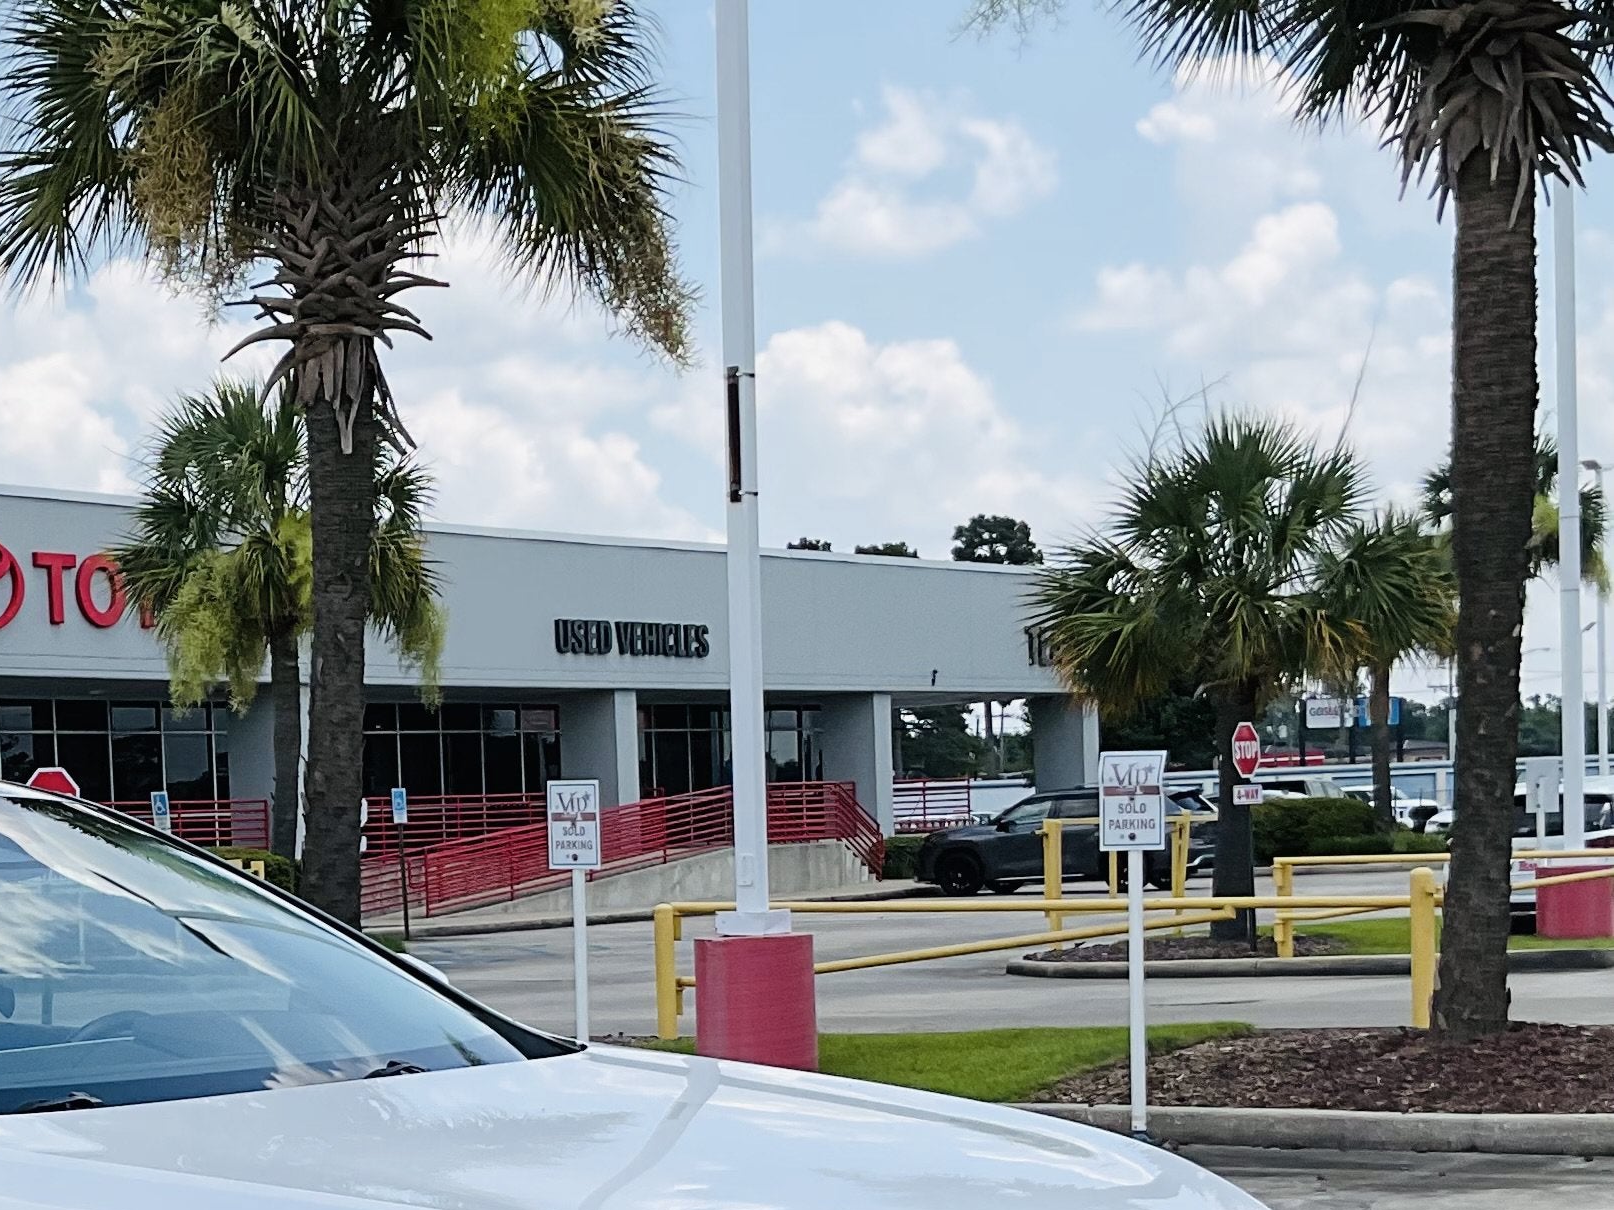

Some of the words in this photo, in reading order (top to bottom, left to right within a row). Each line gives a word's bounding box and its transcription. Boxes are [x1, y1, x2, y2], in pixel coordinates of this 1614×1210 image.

[554, 619, 613, 655] USED
[614, 621, 710, 658] VEHICLES
[1234, 740, 1258, 760] STOP
[1236, 788, 1259, 800] 4-WAY
[1117, 802, 1147, 814] SOLD
[1108, 818, 1156, 830] PARKING
[562, 826, 586, 837] SOLD
[555, 840, 593, 850] PARKING
